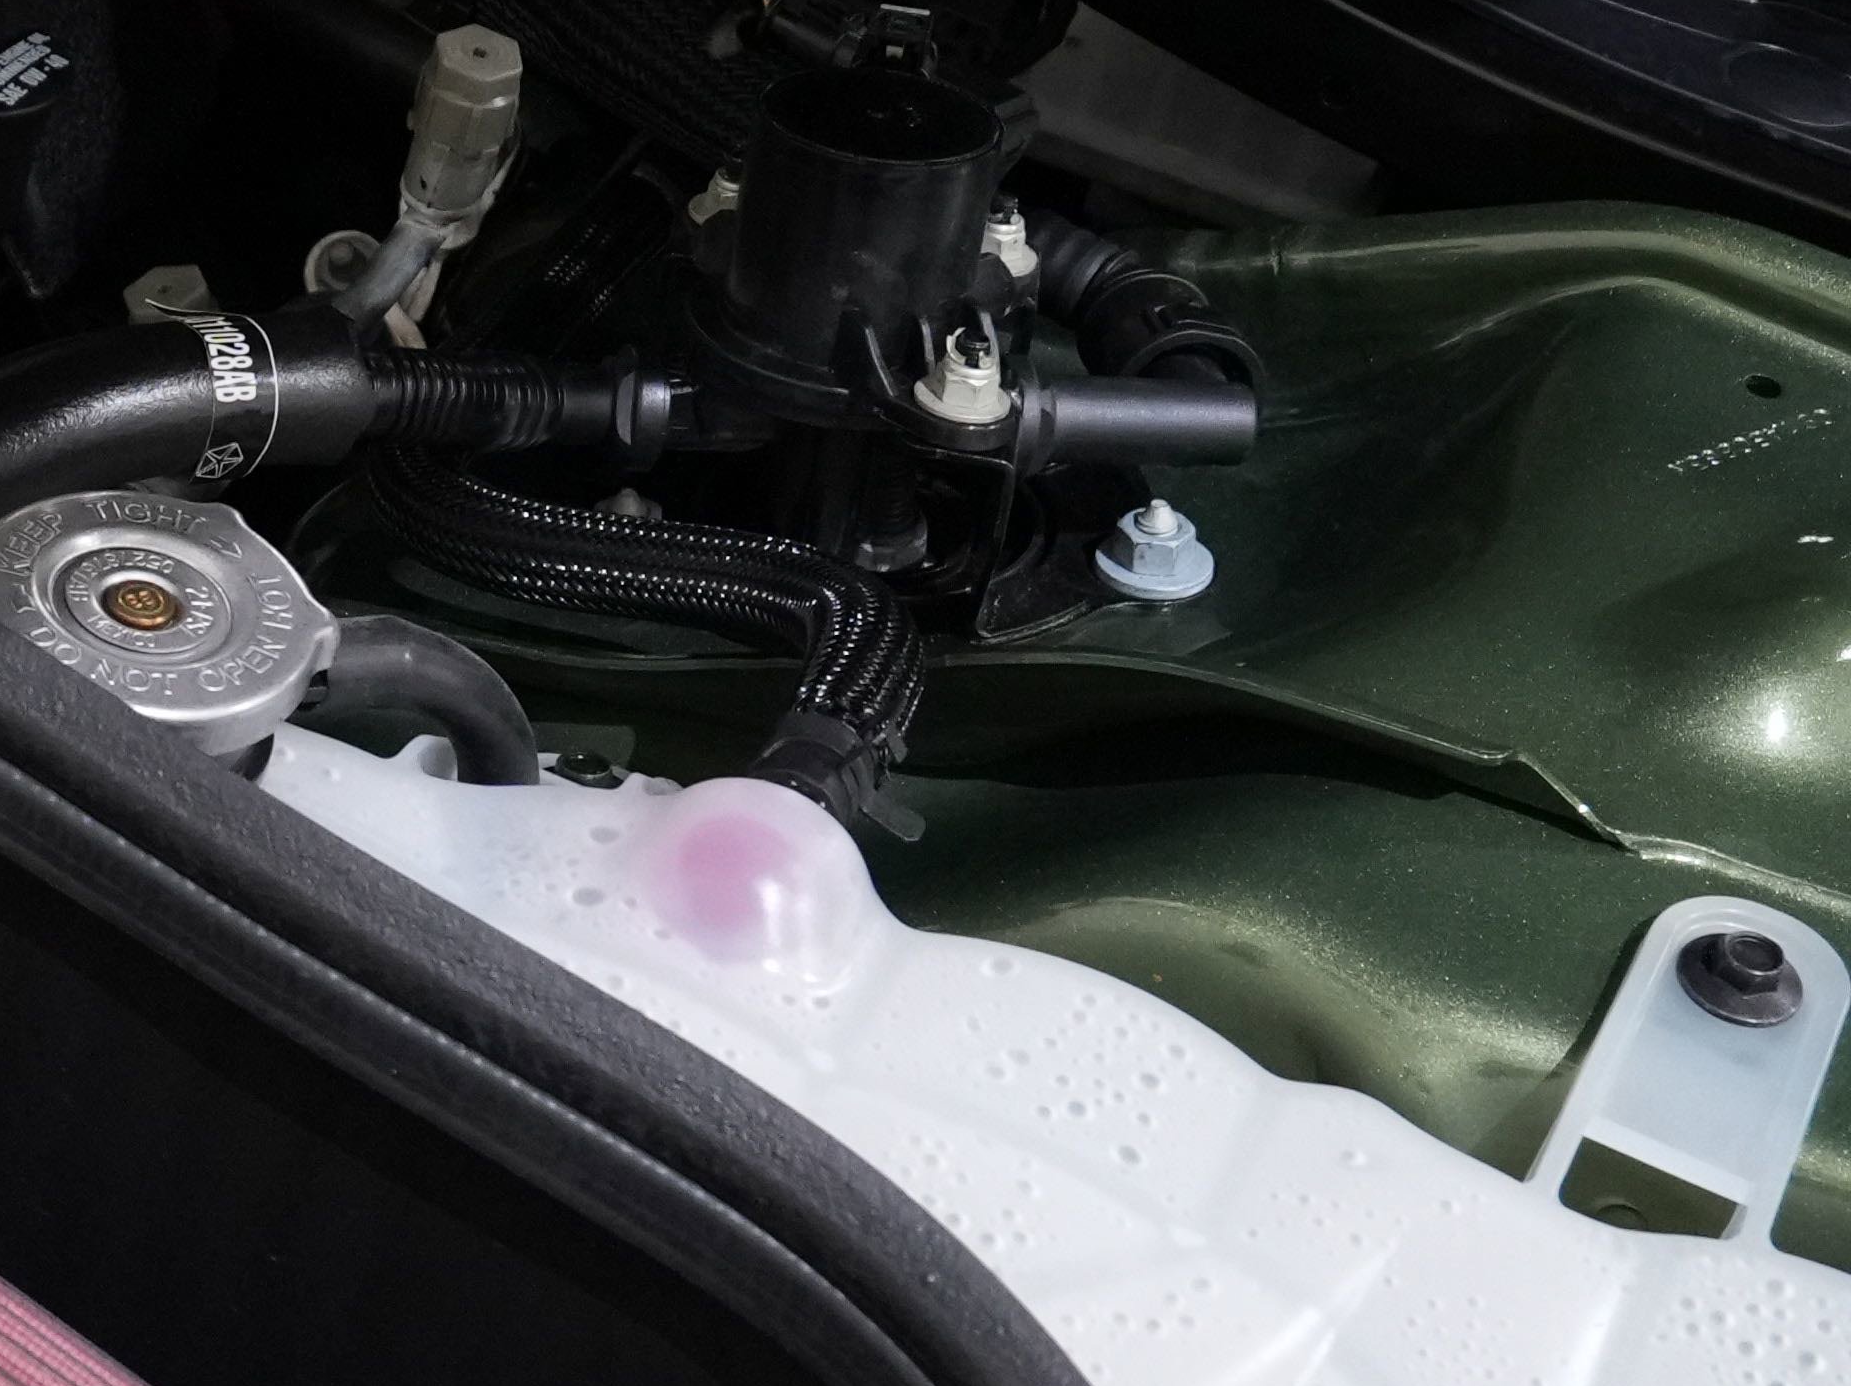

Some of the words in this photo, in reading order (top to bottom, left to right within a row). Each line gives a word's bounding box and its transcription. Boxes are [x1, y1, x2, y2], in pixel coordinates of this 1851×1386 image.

[85, 500, 208, 534] TIGHT
[27, 626, 82, 665] DO
[89, 658, 178, 696] NOT
[199, 634, 288, 692] OPEN
[245, 571, 293, 631] HOT
